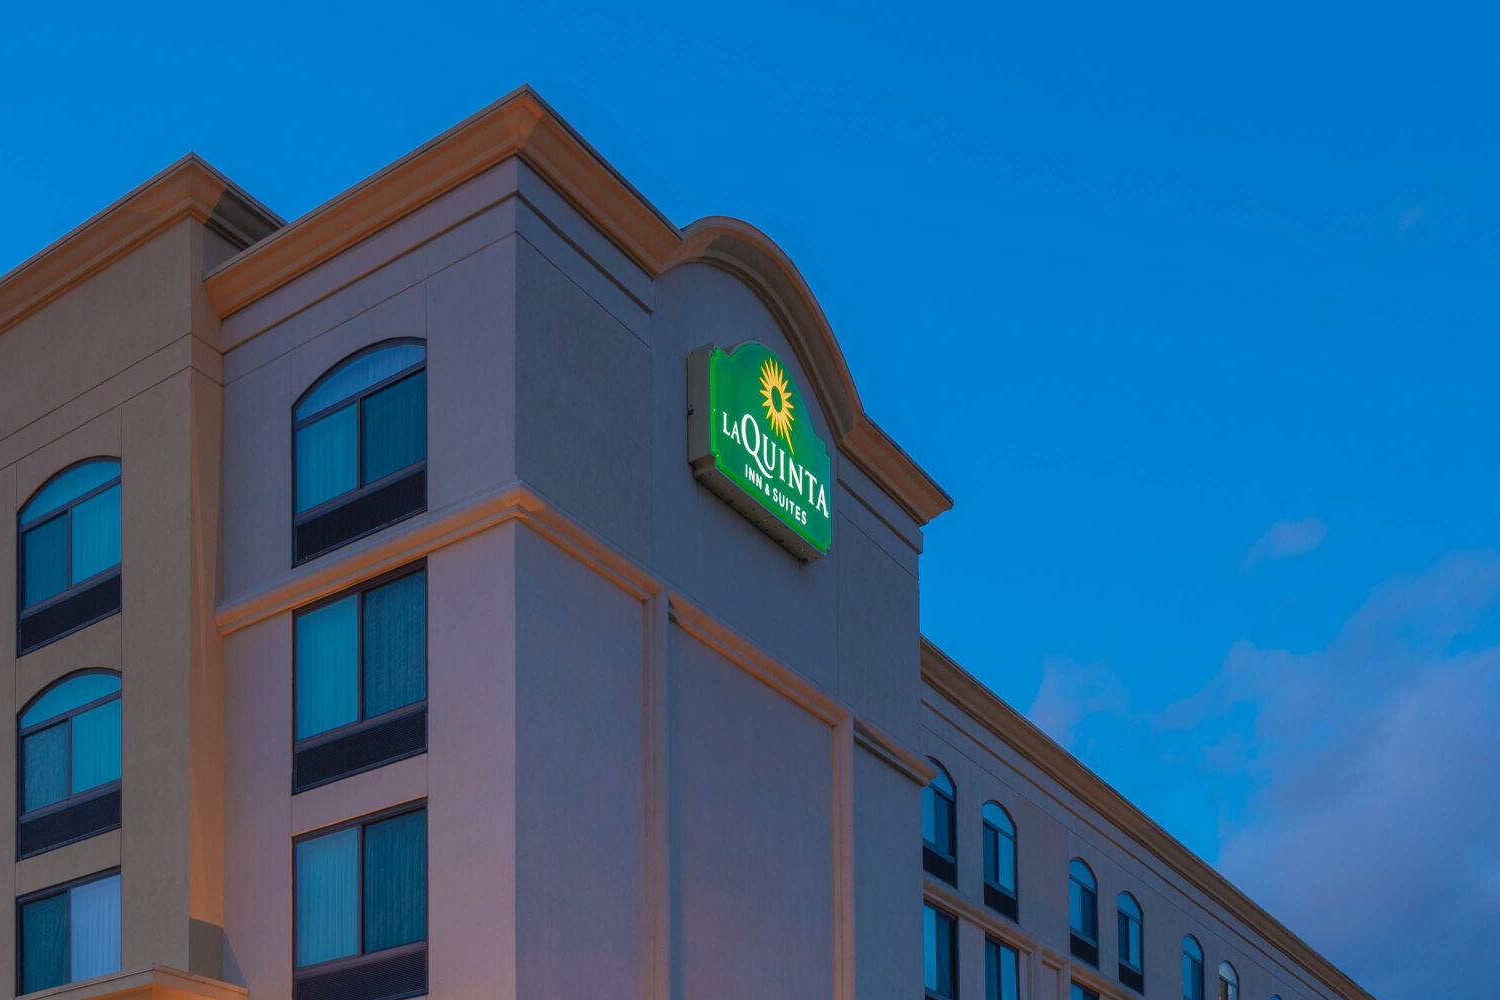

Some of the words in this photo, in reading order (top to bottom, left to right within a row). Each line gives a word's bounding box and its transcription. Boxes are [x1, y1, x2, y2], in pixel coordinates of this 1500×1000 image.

[722, 411, 741, 445] LA
[741, 413, 829, 518] QUINTA
[745, 464, 763, 490] INN
[764, 483, 770, 496] &
[772, 487, 807, 526] SUITES
